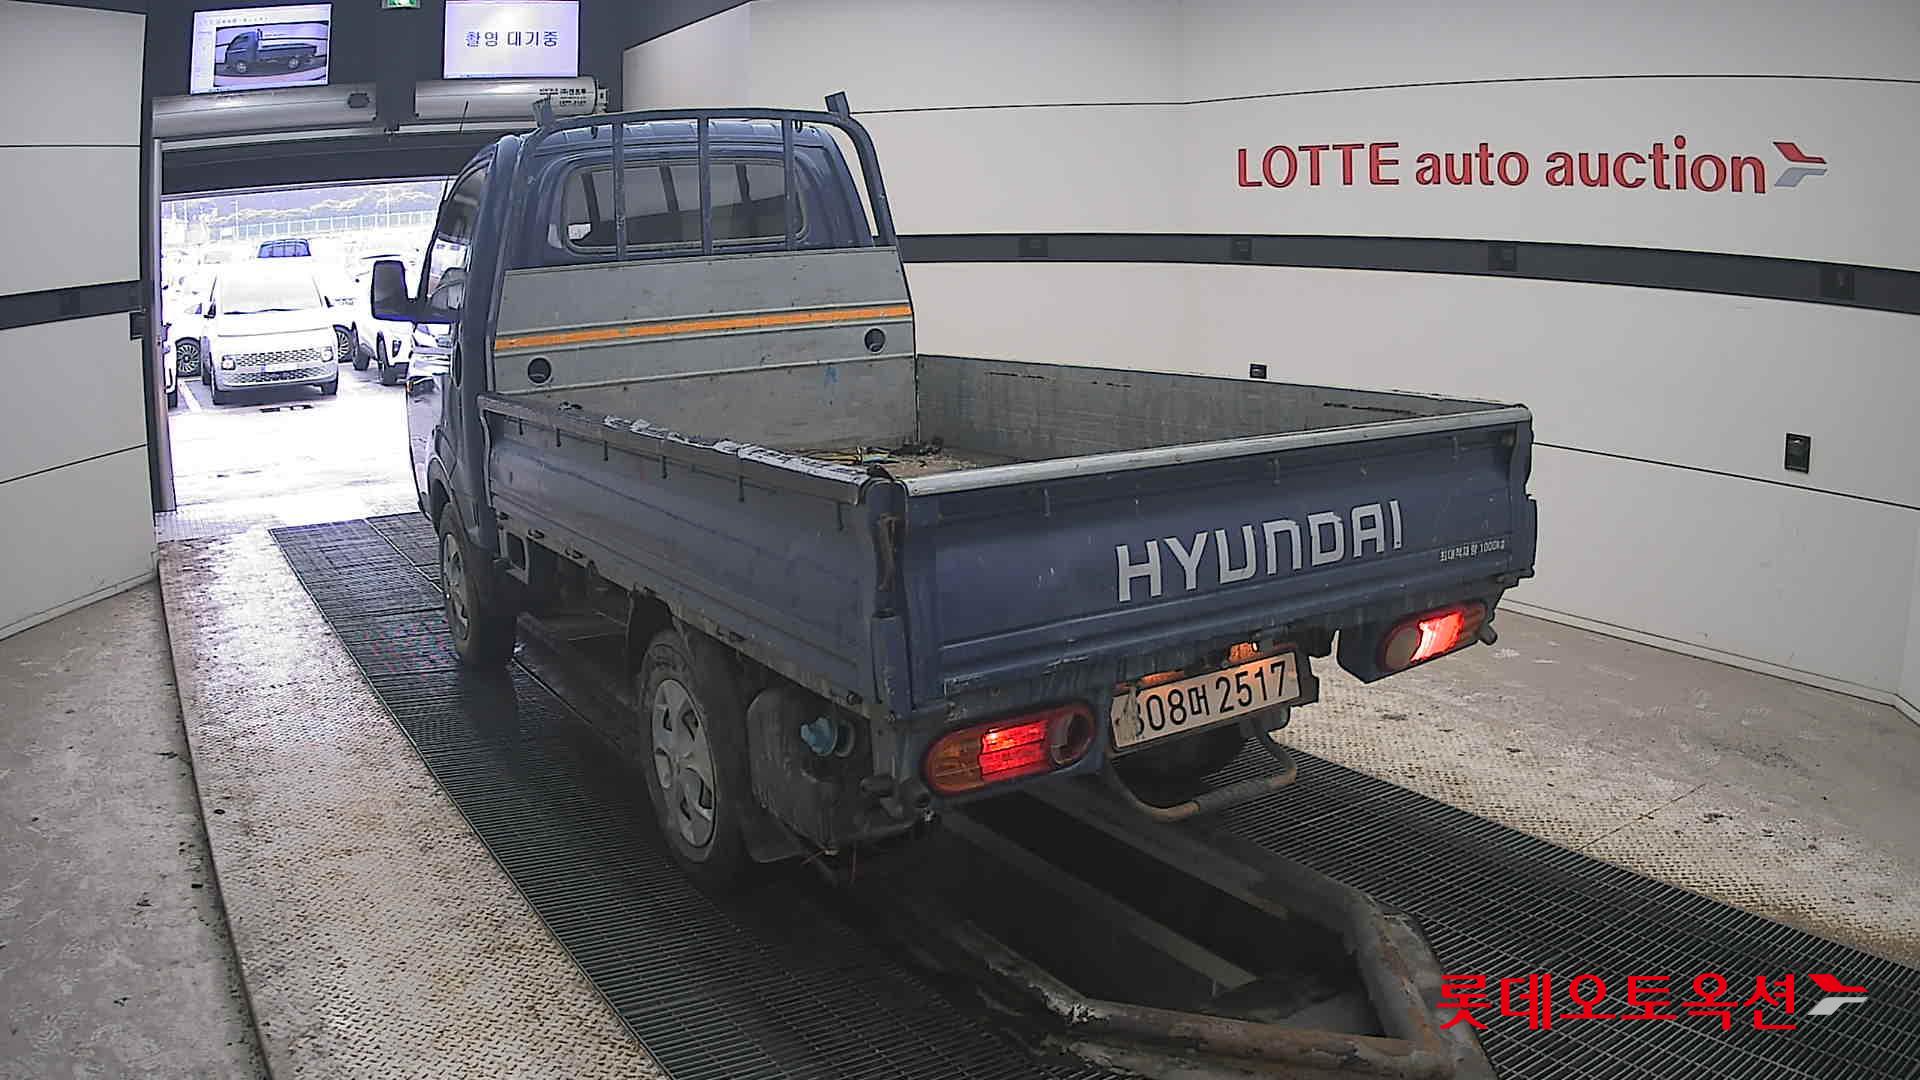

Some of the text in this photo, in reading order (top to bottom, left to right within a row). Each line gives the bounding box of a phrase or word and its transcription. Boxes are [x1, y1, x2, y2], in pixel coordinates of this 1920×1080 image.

[507, 31, 559, 47] 대기중
[1237, 135, 1767, 194] LOTTE auto auction
[1115, 499, 1403, 602] HYUNDAI
